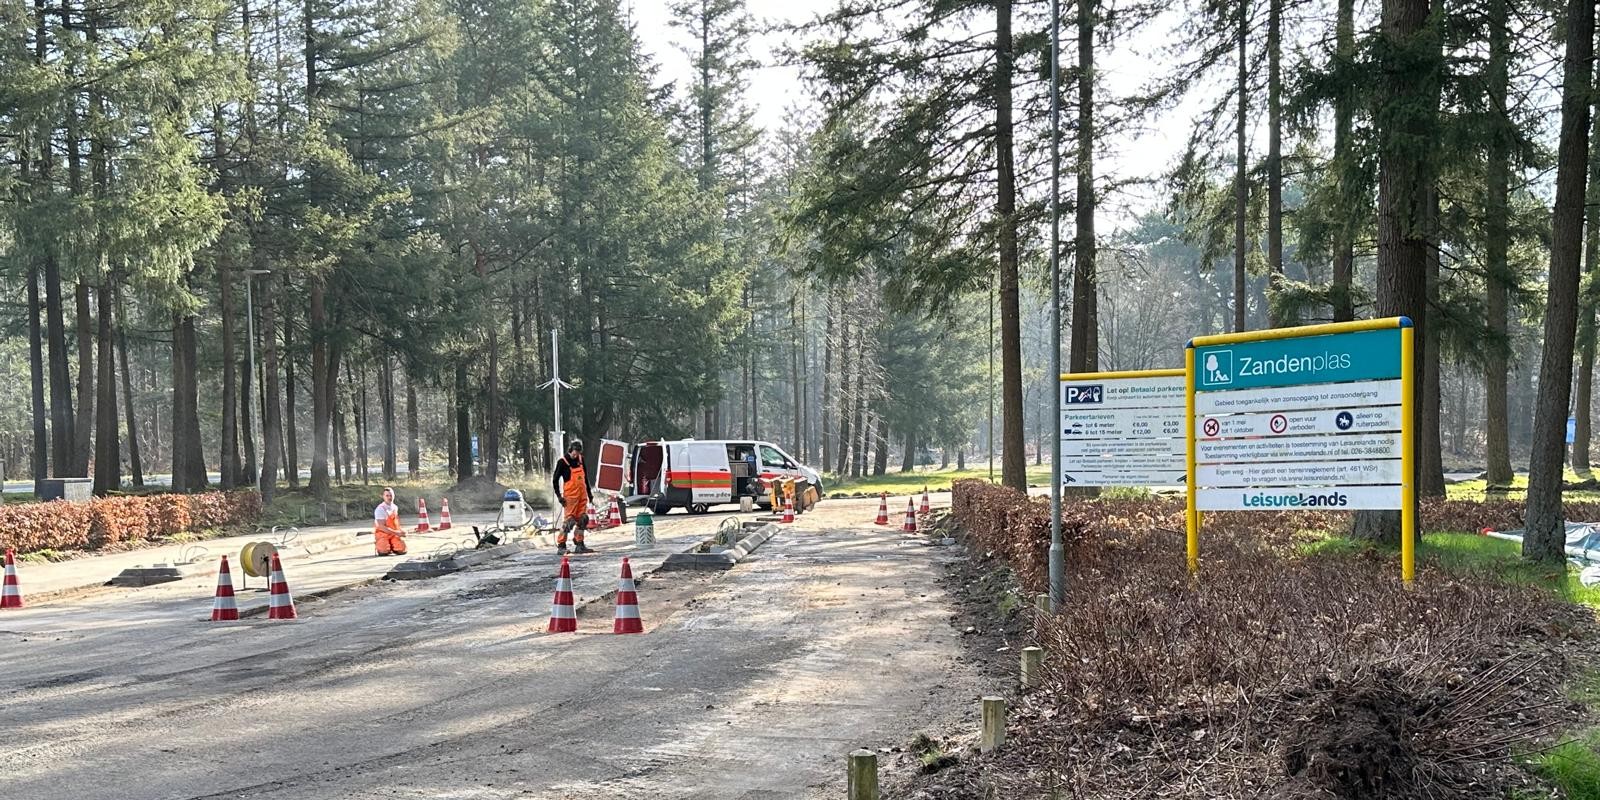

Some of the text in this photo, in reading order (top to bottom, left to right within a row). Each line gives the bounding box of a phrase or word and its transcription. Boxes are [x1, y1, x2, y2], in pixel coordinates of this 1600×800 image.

[1239, 350, 1350, 376] Zandenplas
[1236, 397, 1270, 406] toegankelijk
[1283, 394, 1319, 402] zonsopgang
[1330, 391, 1378, 399] zonsondergang
[1289, 466, 1335, 474] terreinreglement
[1243, 492, 1347, 507] LeisureLands
